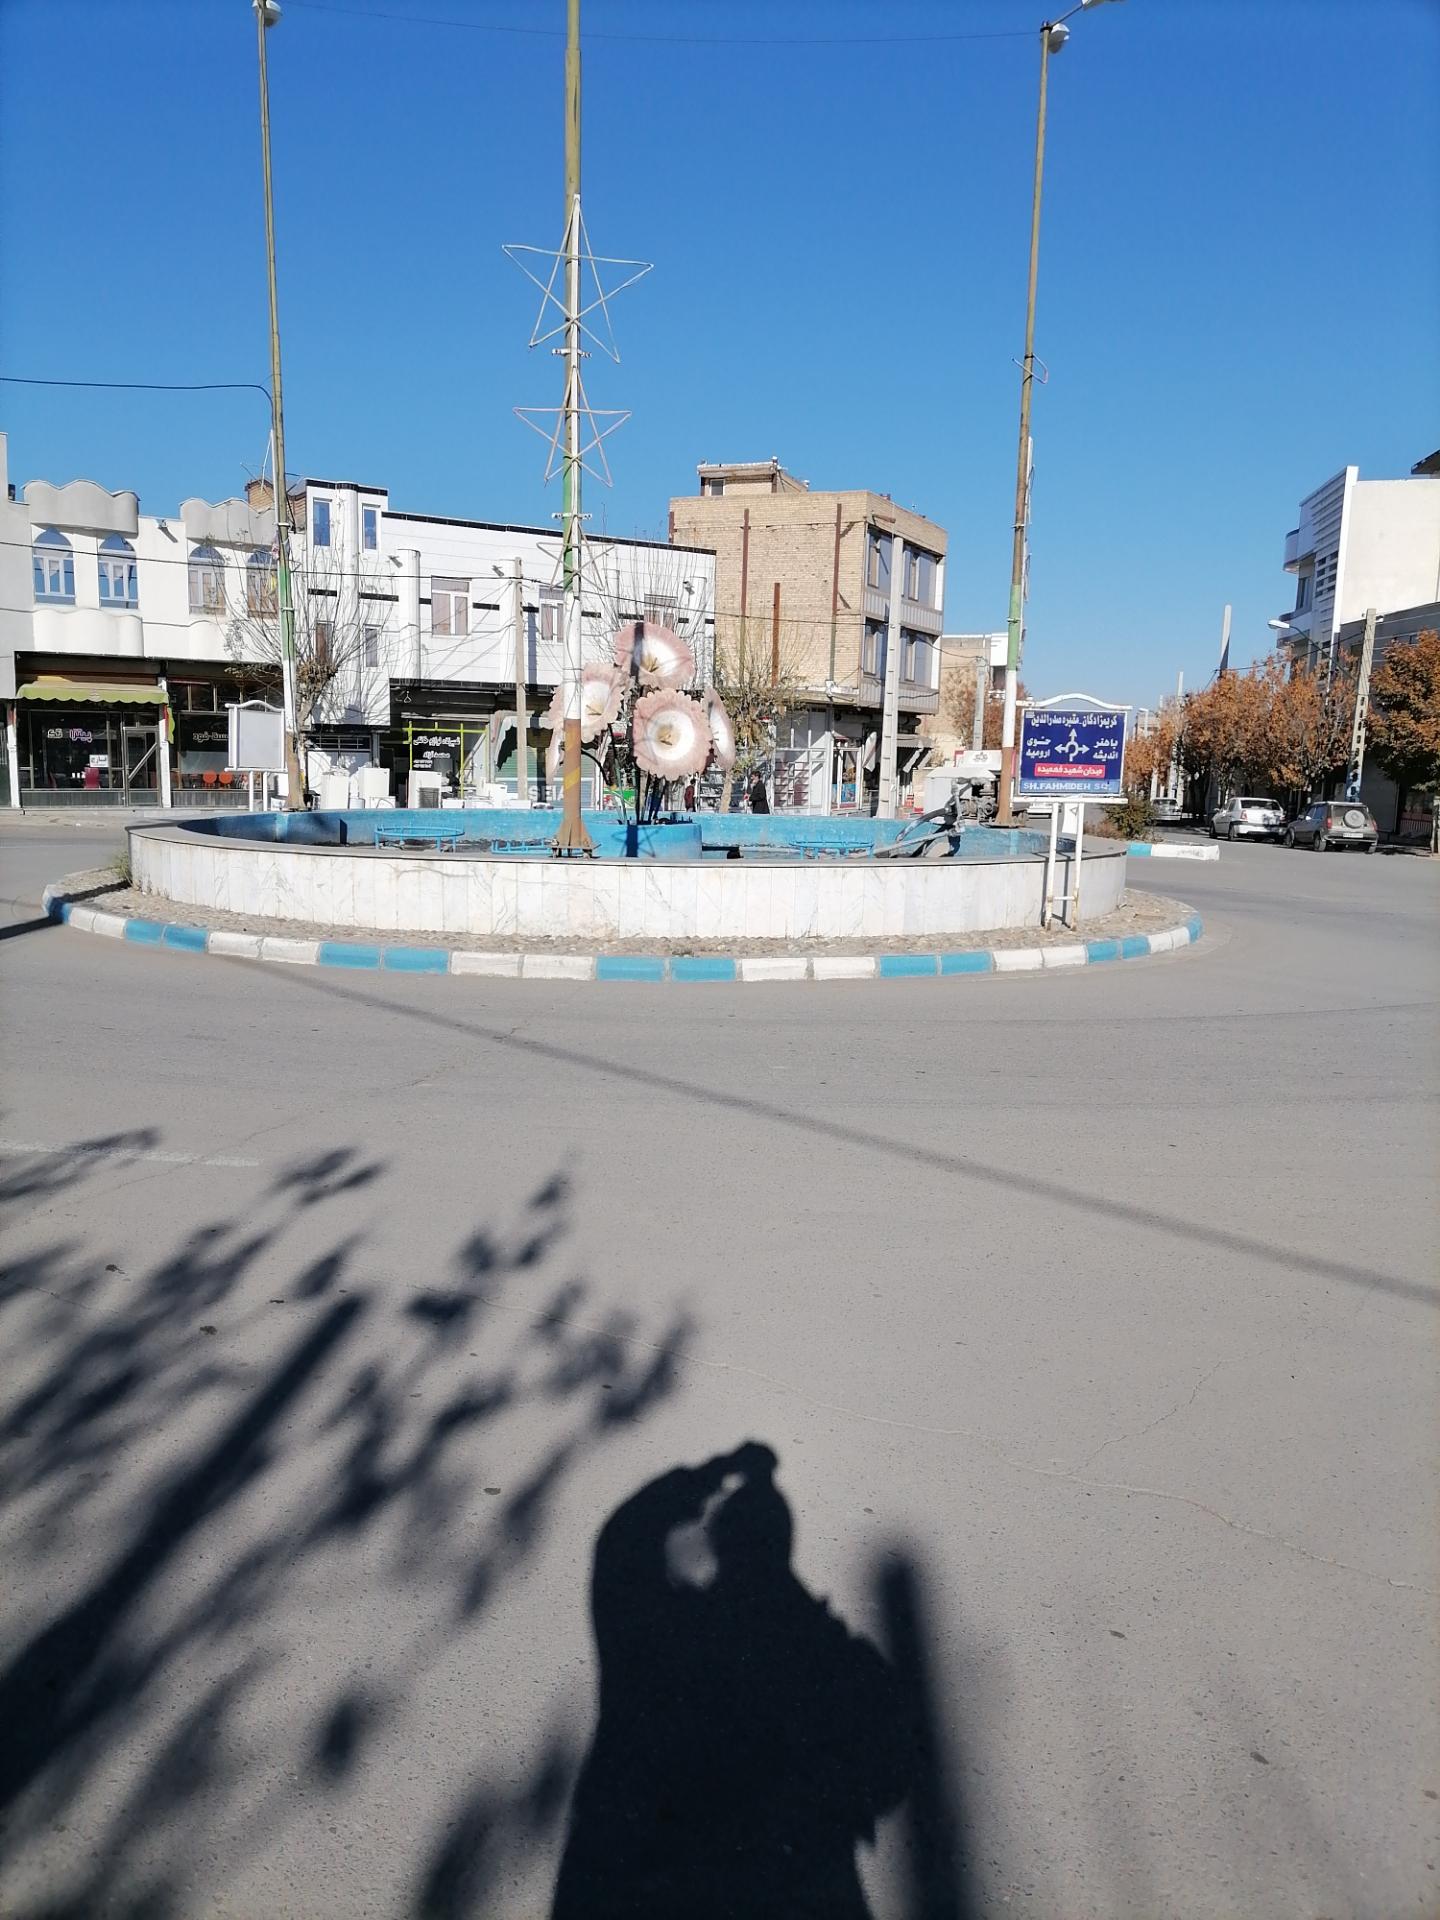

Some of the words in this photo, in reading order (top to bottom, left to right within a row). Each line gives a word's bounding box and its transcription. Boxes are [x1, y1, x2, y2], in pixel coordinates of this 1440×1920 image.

[1027, 736, 1051, 746] خوی
[1026, 749, 1050, 758] ارومیه
[1093, 749, 1118, 761] اندیشه
[1037, 765, 1063, 775] فهمیده
[1063, 765, 1083, 774] شهید
[1083, 767, 1102, 776] میدان
